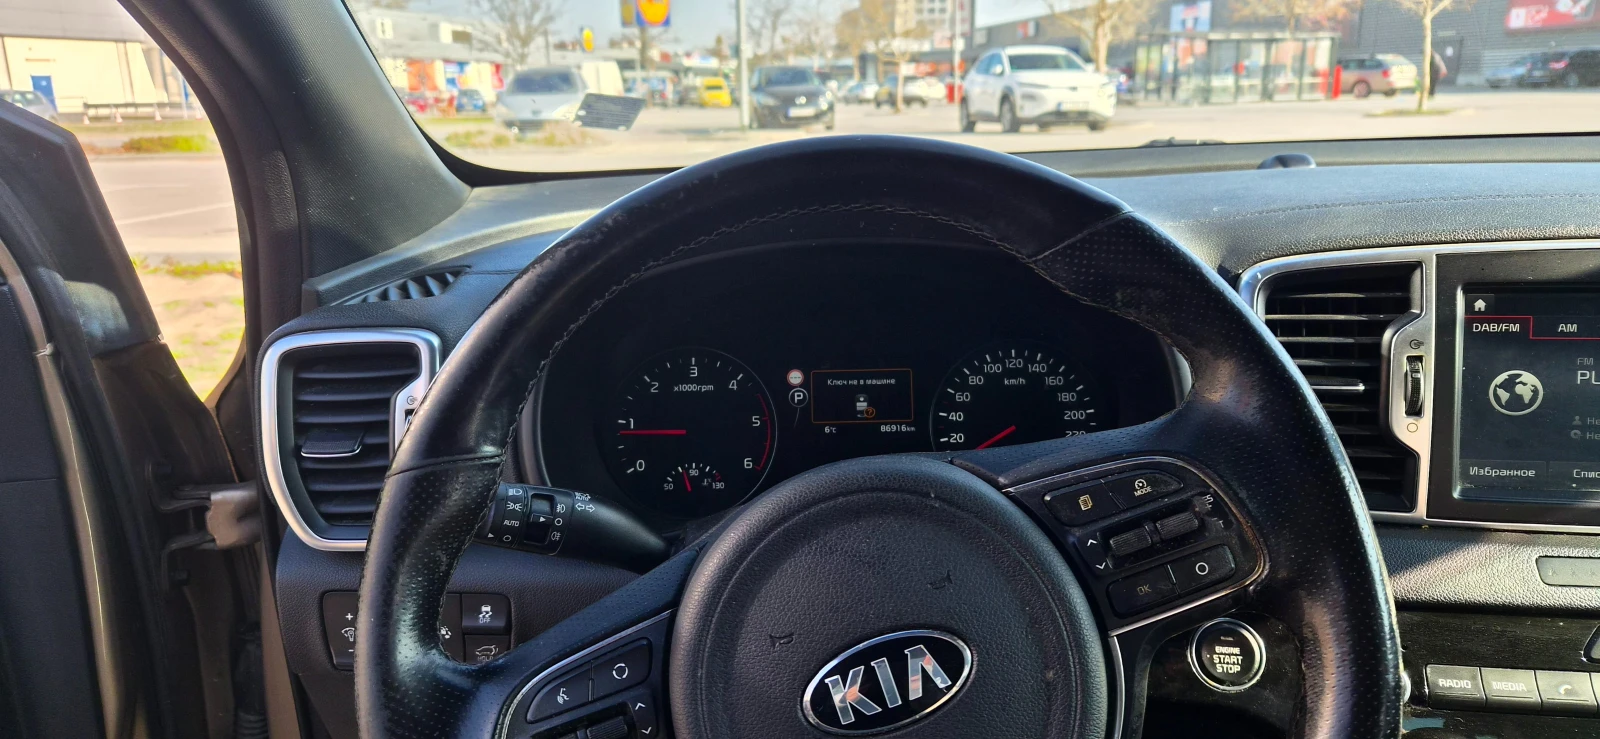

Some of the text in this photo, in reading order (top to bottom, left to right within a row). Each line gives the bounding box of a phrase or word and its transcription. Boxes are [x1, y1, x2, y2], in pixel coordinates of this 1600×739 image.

[1472, 323, 1520, 333] DAB/FM
[1558, 323, 1578, 333] AM
[1005, 359, 1024, 368] 120
[1577, 357, 1594, 366] FM
[690, 366, 698, 377] 3
[983, 363, 1002, 373] 100
[1028, 363, 1047, 373] 140
[827, 378, 847, 386] Ключ
[968, 375, 984, 385] 80
[1045, 376, 1064, 386] 160
[650, 381, 659, 393] 2
[673, 384, 714, 392] x1000rpm
[728, 380, 738, 391] 4
[955, 392, 970, 402] 60
[1057, 392, 1077, 402] 180
[949, 412, 964, 421] 40
[1063, 410, 1086, 420] 200
[629, 418, 634, 429] 1
[752, 415, 761, 427] 5
[950, 433, 964, 443] 20
[636, 460, 645, 472] 0
[744, 458, 753, 469] 6
[689, 469, 699, 477] 90
[1469, 467, 1535, 477] Избранное
[712, 482, 725, 490] 130
[1134, 486, 1152, 497] MODE
[503, 519, 519, 527] AUTO
[1137, 585, 1151, 595] OK
[1215, 646, 1240, 654] ENGINE
[1212, 654, 1243, 664] START
[1216, 664, 1240, 673] STOP
[824, 644, 952, 725] KIA
[1439, 679, 1471, 689] RADIO
[1493, 681, 1527, 692] MEDIA
